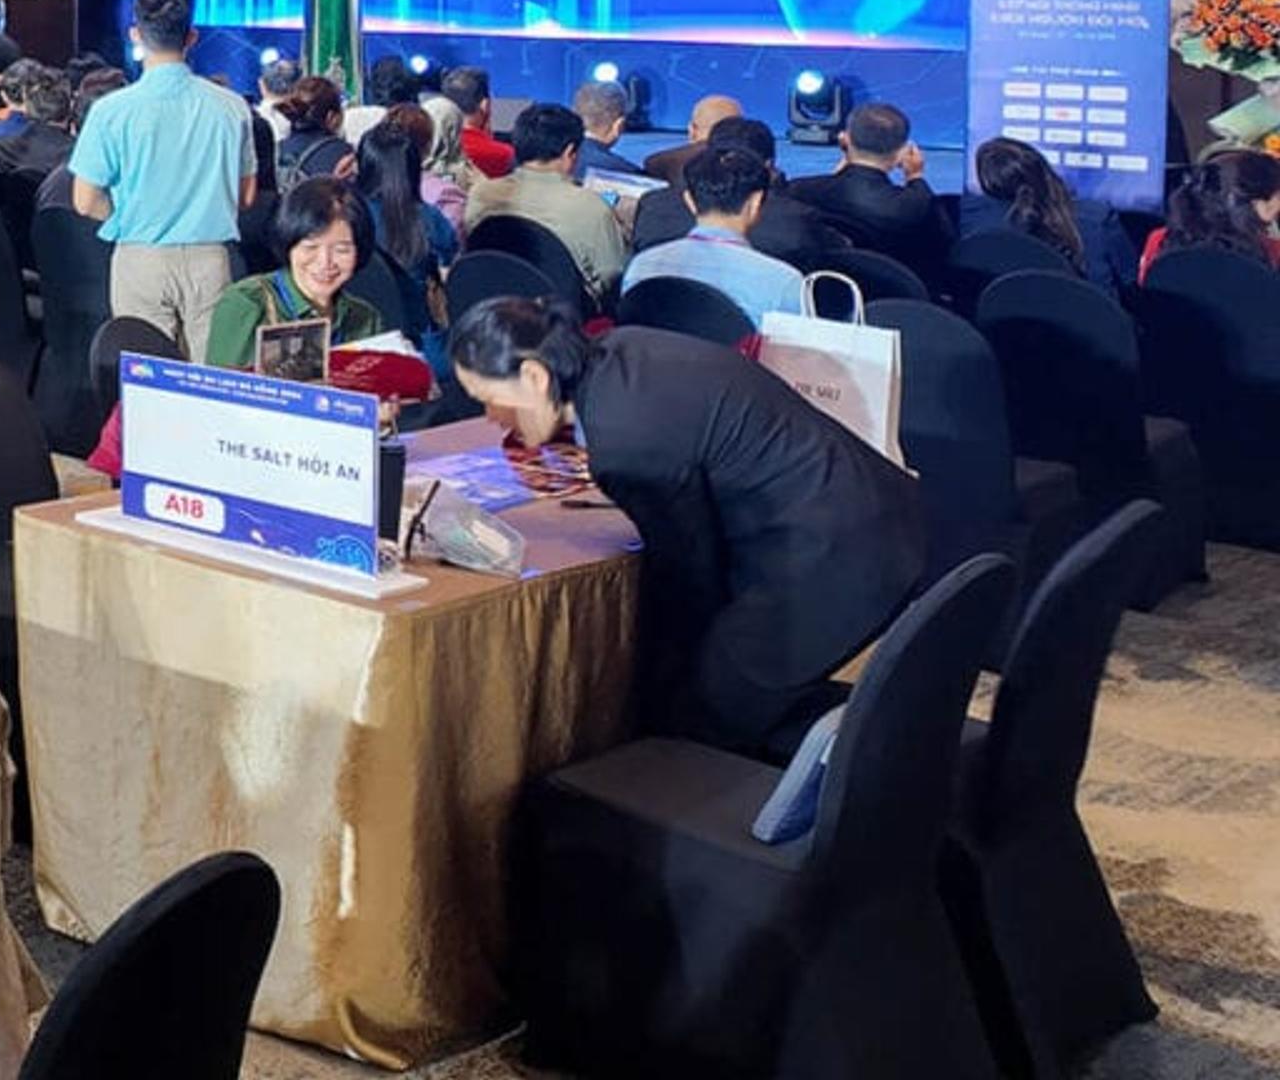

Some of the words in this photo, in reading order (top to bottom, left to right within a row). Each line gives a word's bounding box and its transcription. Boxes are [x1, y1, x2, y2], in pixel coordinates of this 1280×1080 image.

[216, 439, 248, 459] THE
[251, 446, 293, 468] SALT
[337, 464, 362, 482] AN
[164, 493, 205, 520] A18
